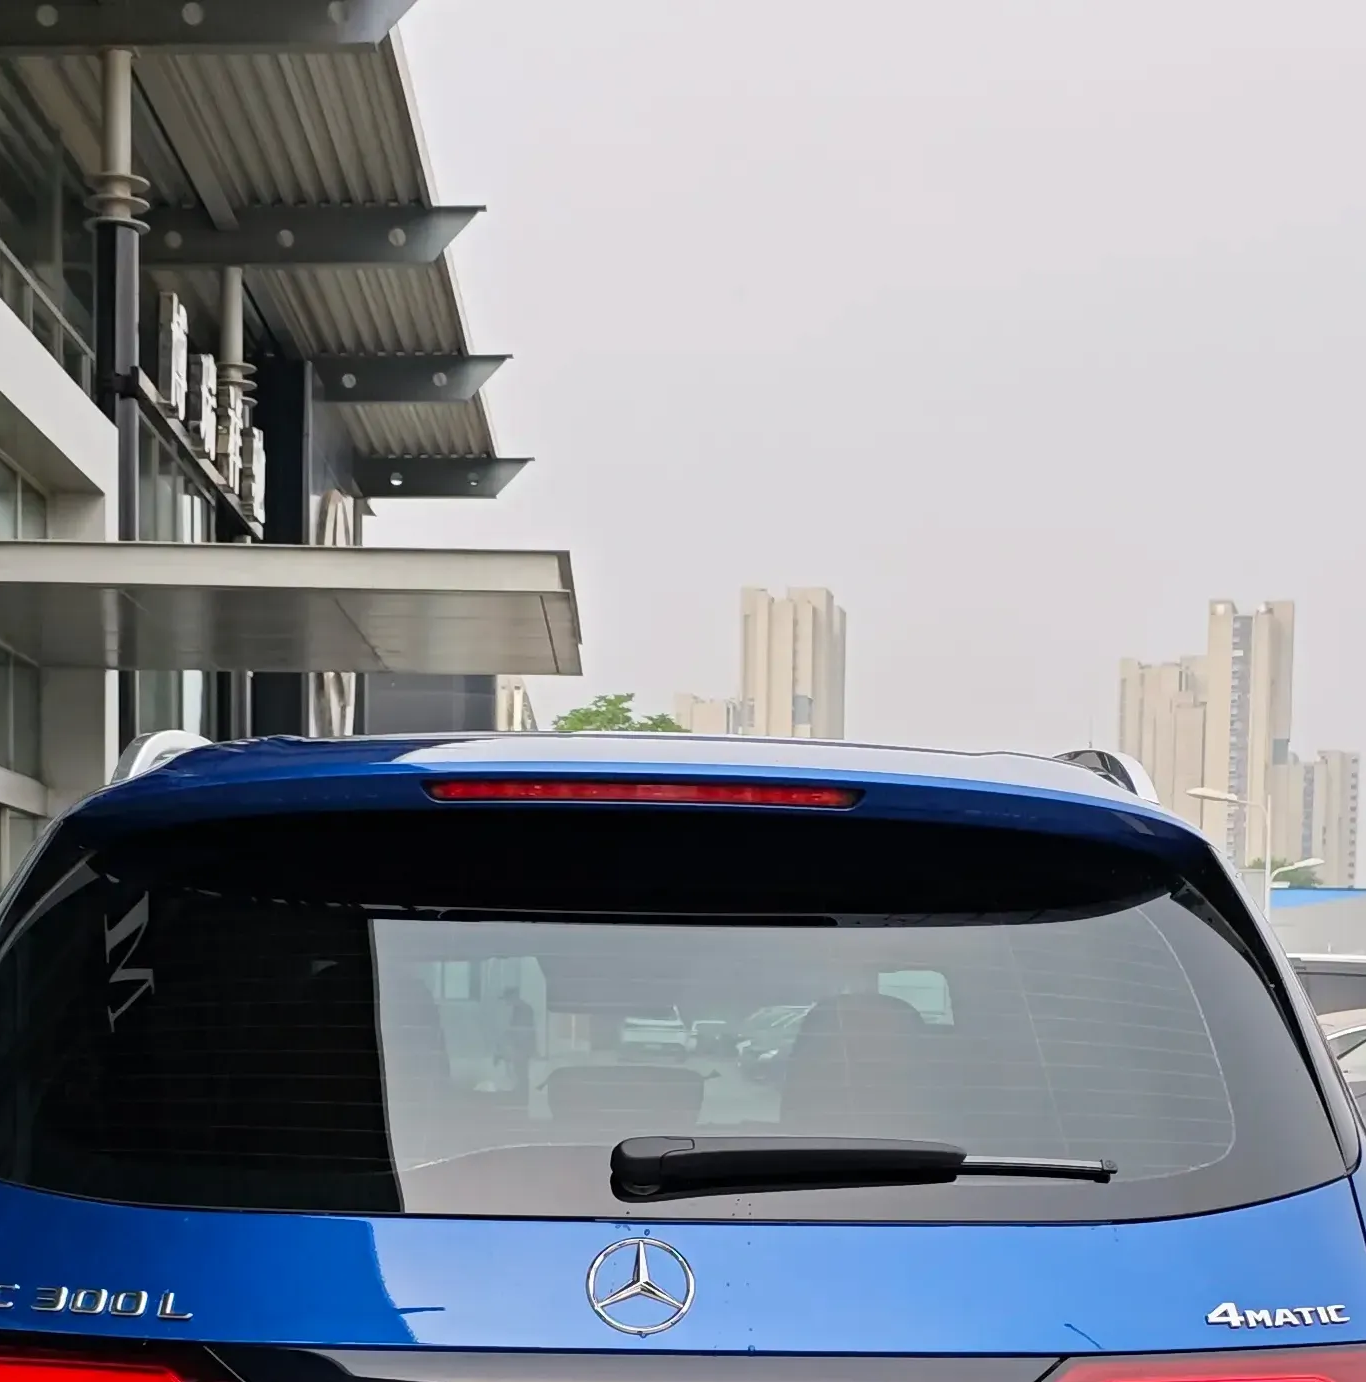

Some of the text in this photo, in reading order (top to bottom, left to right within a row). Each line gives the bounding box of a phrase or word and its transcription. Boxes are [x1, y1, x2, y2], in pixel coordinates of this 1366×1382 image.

[30, 1286, 148, 1316] 300
[156, 1289, 194, 1319] L
[1206, 1302, 1351, 1329] 4MATIC
